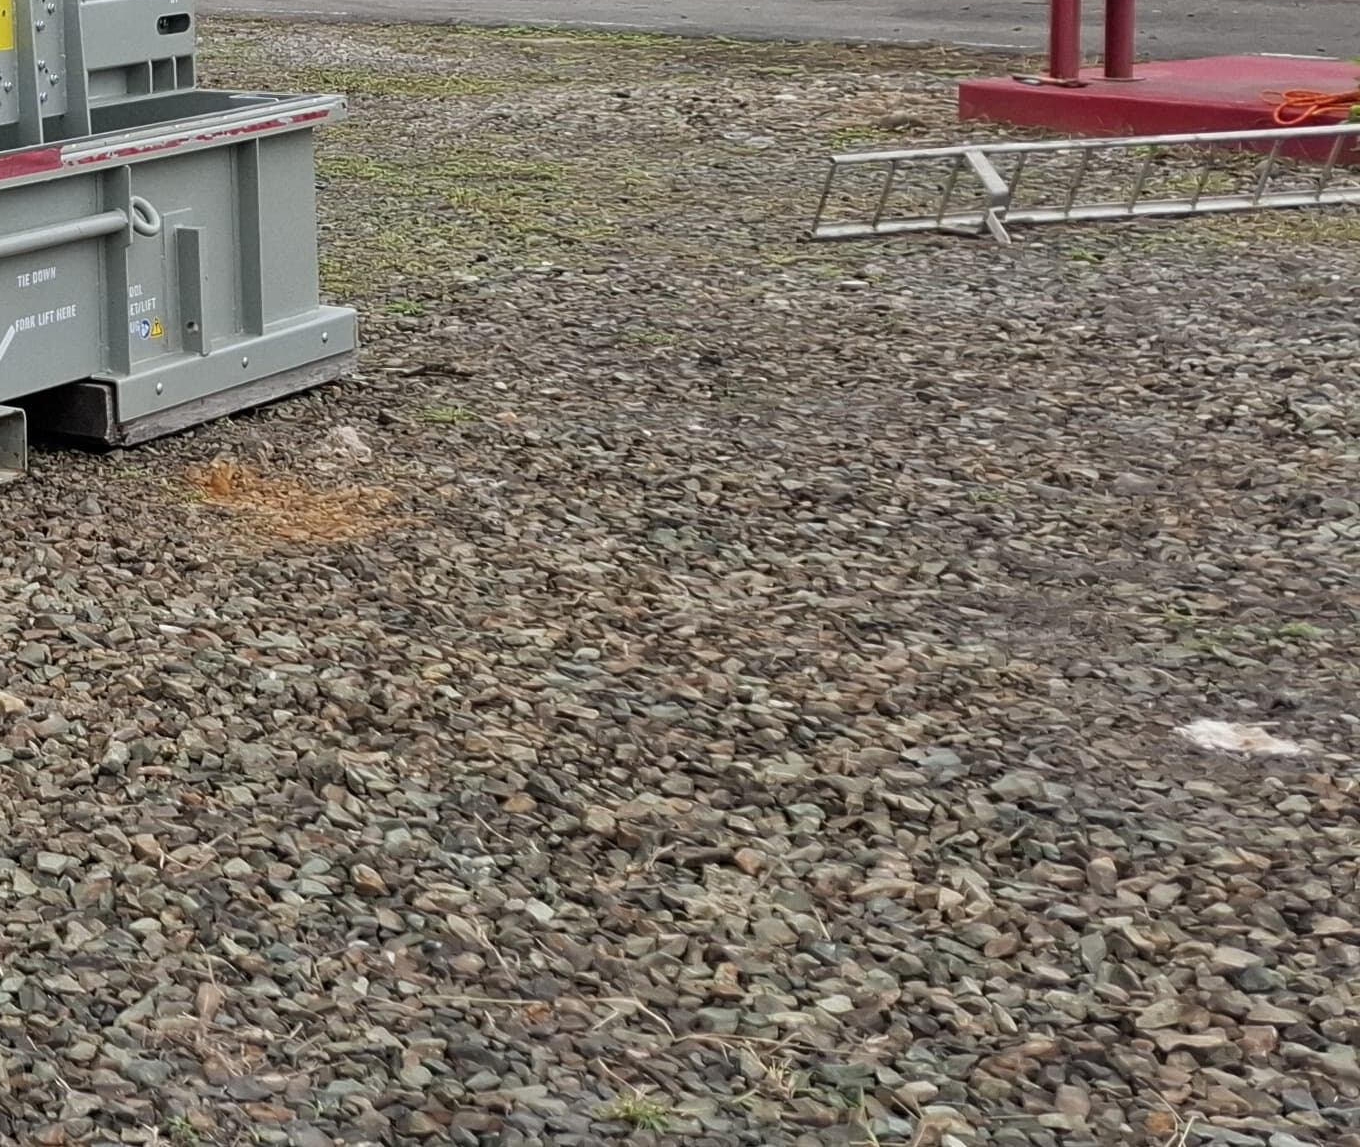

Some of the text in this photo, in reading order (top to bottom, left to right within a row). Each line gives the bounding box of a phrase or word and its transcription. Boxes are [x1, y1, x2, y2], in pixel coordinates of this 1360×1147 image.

[16, 266, 56, 288] TIE DOWN
[15, 304, 76, 332] FORK LIFT HERE
